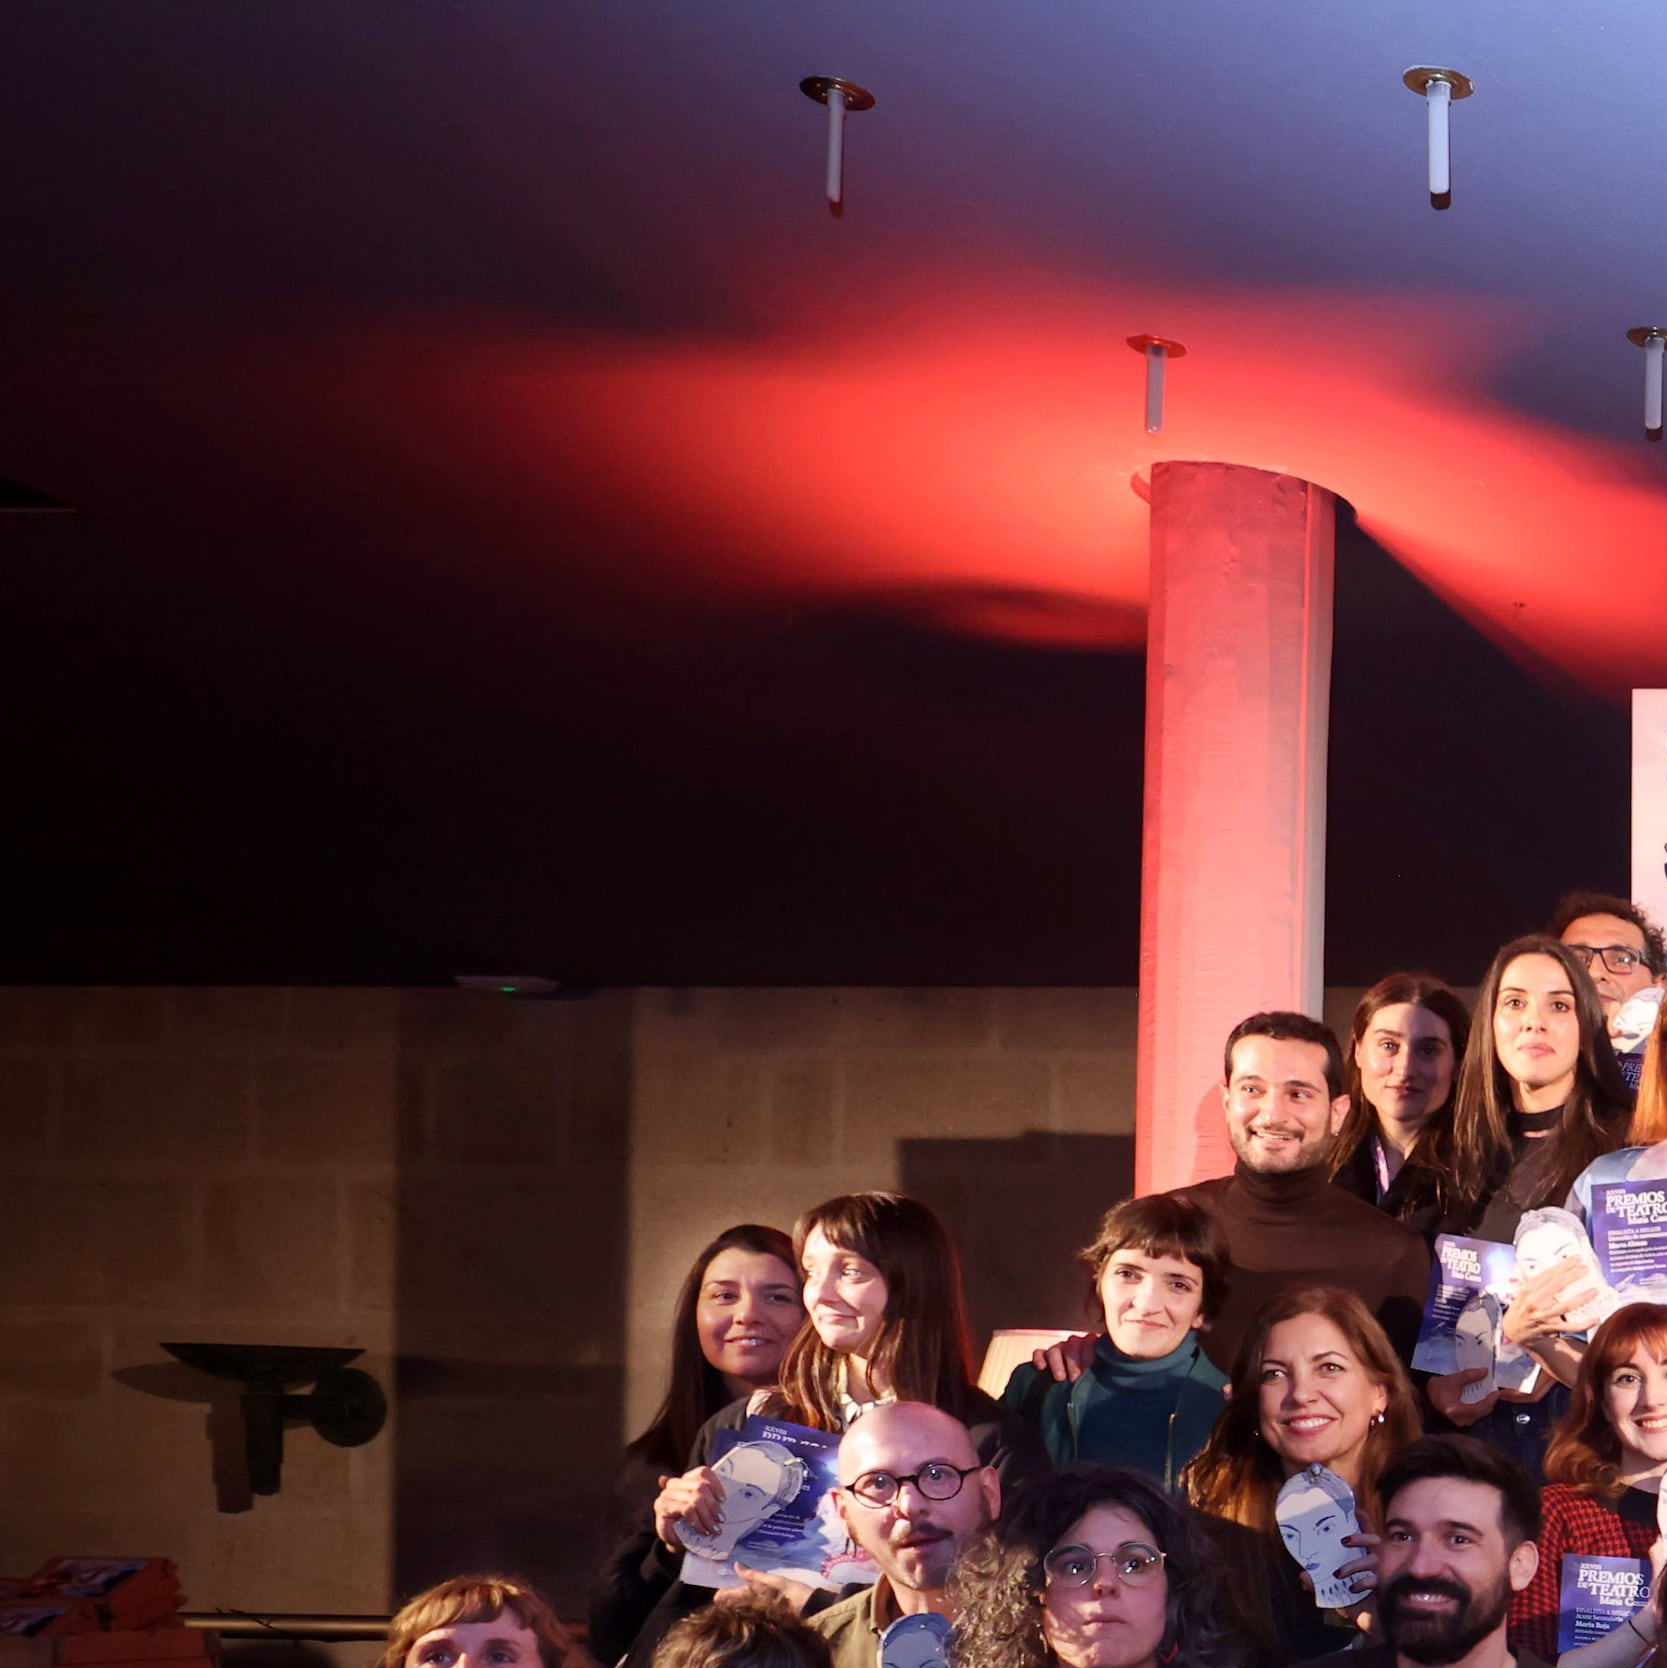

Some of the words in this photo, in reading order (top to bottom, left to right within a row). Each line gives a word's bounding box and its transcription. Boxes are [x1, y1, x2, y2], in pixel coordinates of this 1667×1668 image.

[1606, 1190, 1665, 1208] PREMIOS
[1578, 1569, 1645, 1585] PREMIOS
[1589, 1582, 1651, 1598] TEATRO
